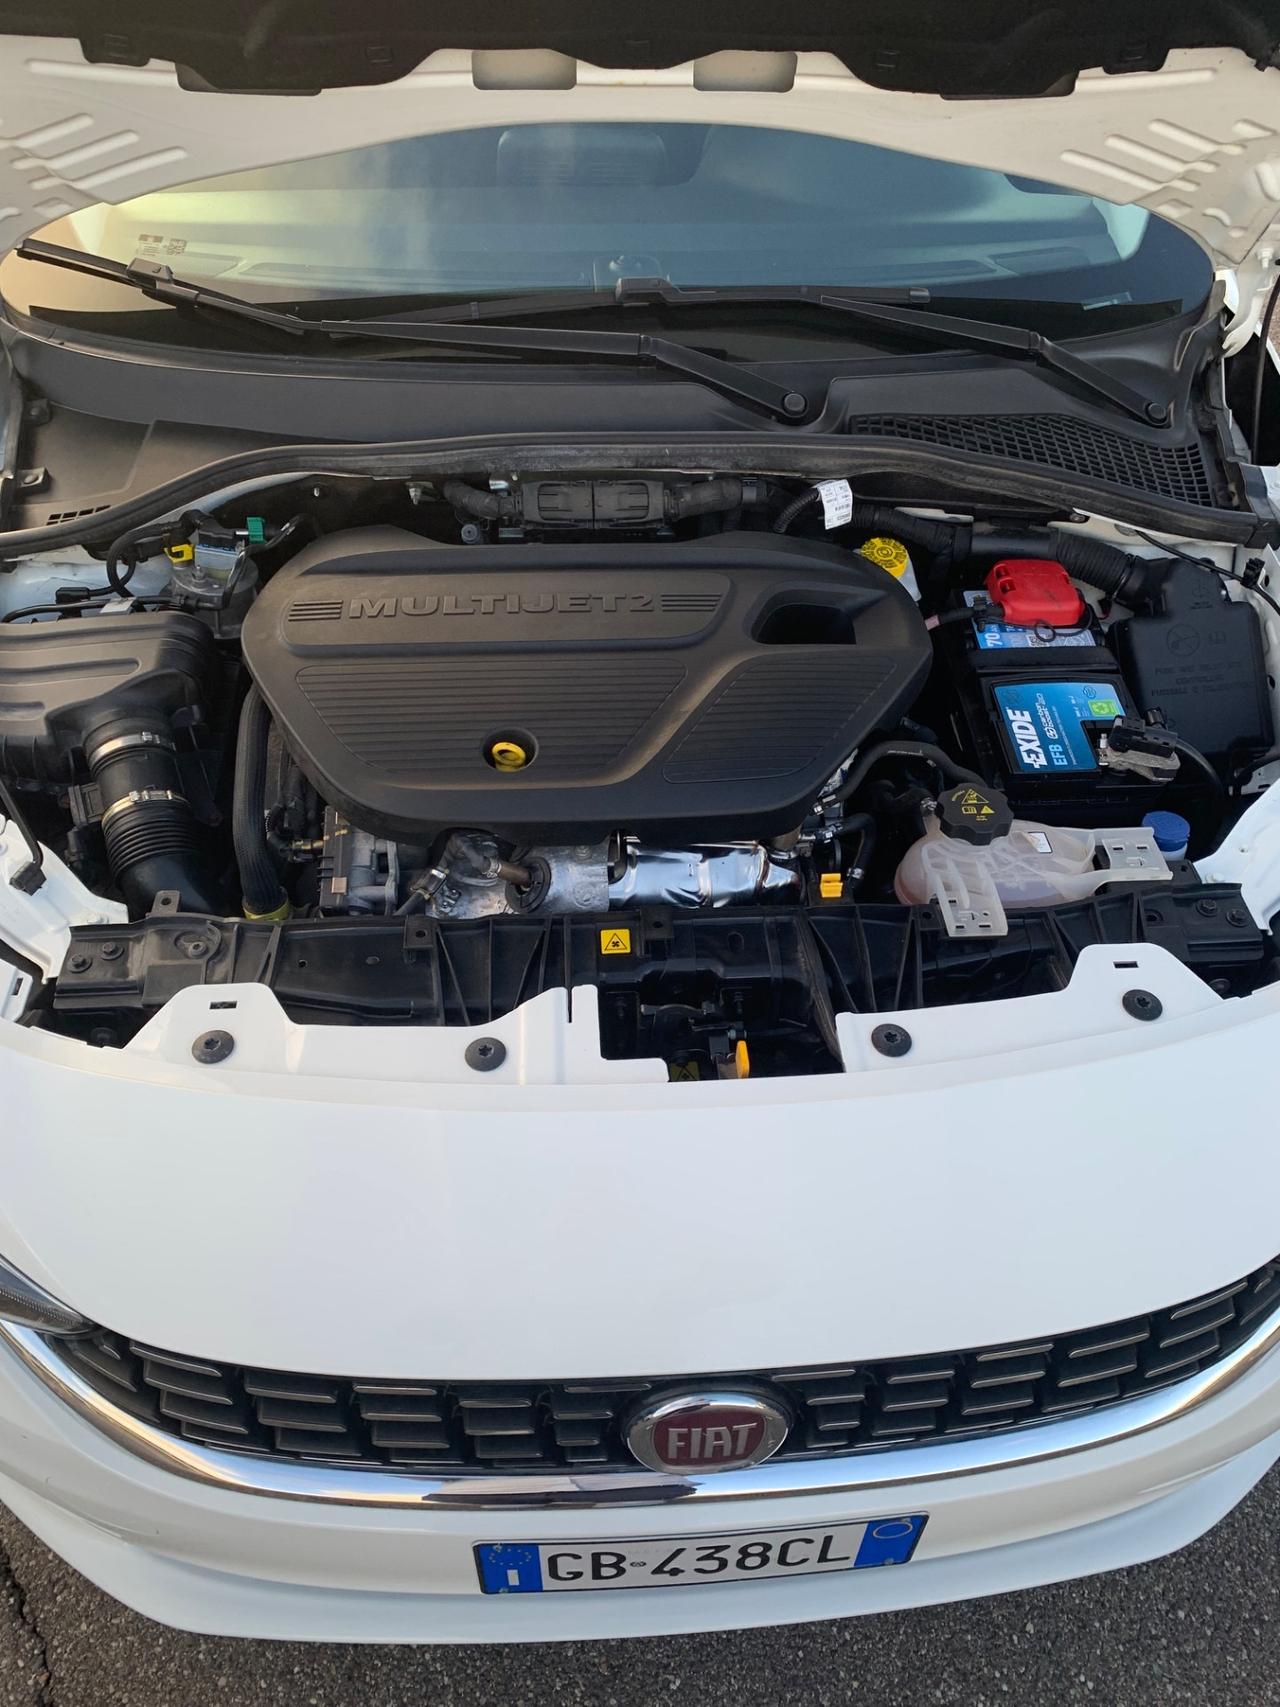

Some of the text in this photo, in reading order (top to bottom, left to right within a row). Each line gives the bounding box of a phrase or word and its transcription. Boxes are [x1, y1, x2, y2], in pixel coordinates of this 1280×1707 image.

[985, 633, 1003, 647] 70
[1007, 709, 1048, 768] EXIDE
[1048, 744, 1068, 766] EFB
[667, 1422, 758, 1459] FIAT
